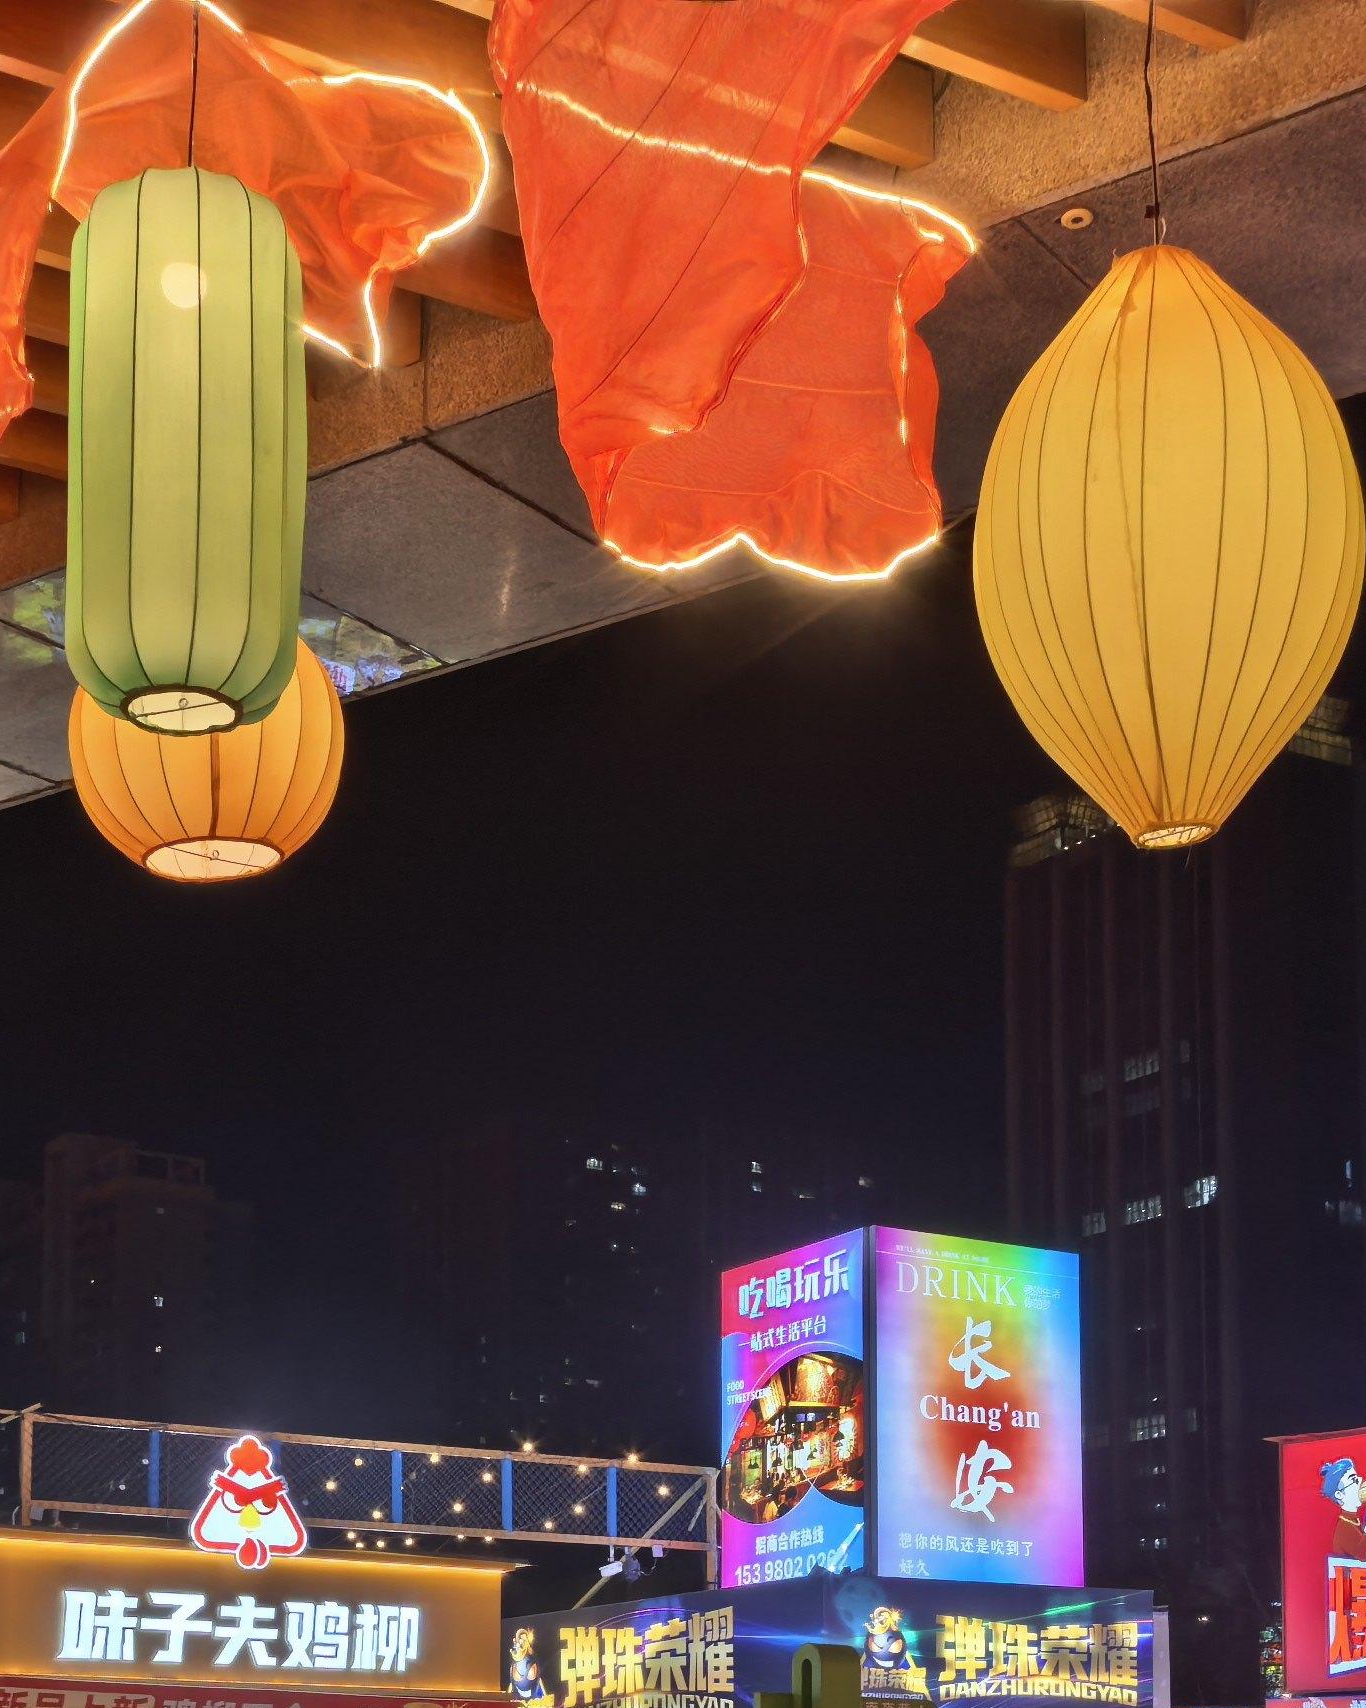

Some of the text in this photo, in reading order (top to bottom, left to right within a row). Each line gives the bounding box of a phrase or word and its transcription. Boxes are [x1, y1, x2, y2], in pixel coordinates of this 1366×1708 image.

[738, 1249, 850, 1319] 吃喝玩乐
[896, 1261, 1017, 1307] DRINK
[738, 1315, 827, 1352] 一站式生活平台
[949, 1317, 1011, 1389] 长
[920, 1395, 1041, 1432] Chang'an
[950, 1440, 1014, 1523] 安
[898, 1532, 1034, 1557] 想你的风还是吹到了
[898, 1558, 930, 1577] 好久
[56, 1589, 421, 1672] 味子夫鸡柳
[559, 1605, 735, 1708] 弹珠荣耀
[935, 1614, 1138, 1687] 弹珠荣耀
[939, 1679, 1138, 1707] DANZHURONGYAO
